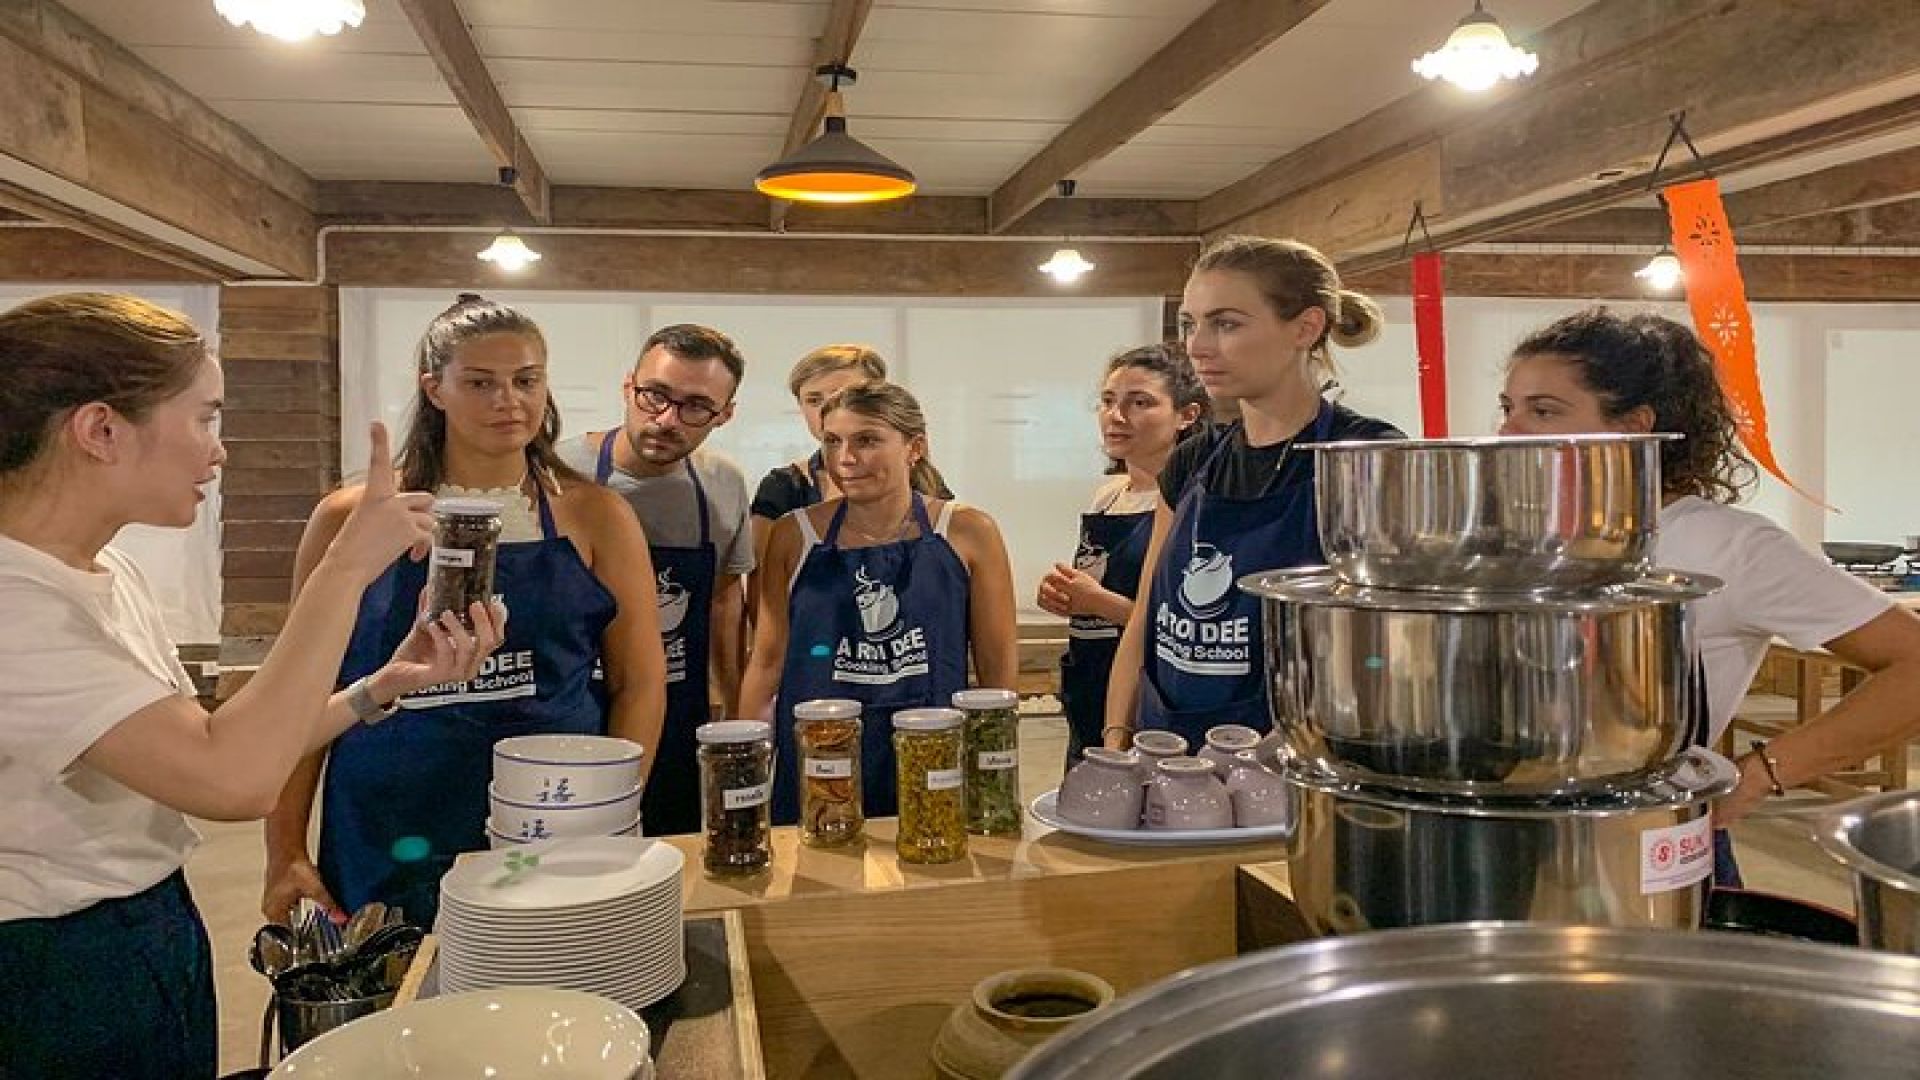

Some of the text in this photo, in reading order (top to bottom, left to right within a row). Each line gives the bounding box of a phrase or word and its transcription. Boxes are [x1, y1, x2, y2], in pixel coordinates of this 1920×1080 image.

[890, 627, 926, 658] DEE
[1201, 616, 1249, 643] DEE
[480, 649, 533, 676] DEE
[1194, 645, 1249, 660] School
[474, 669, 534, 690] School
